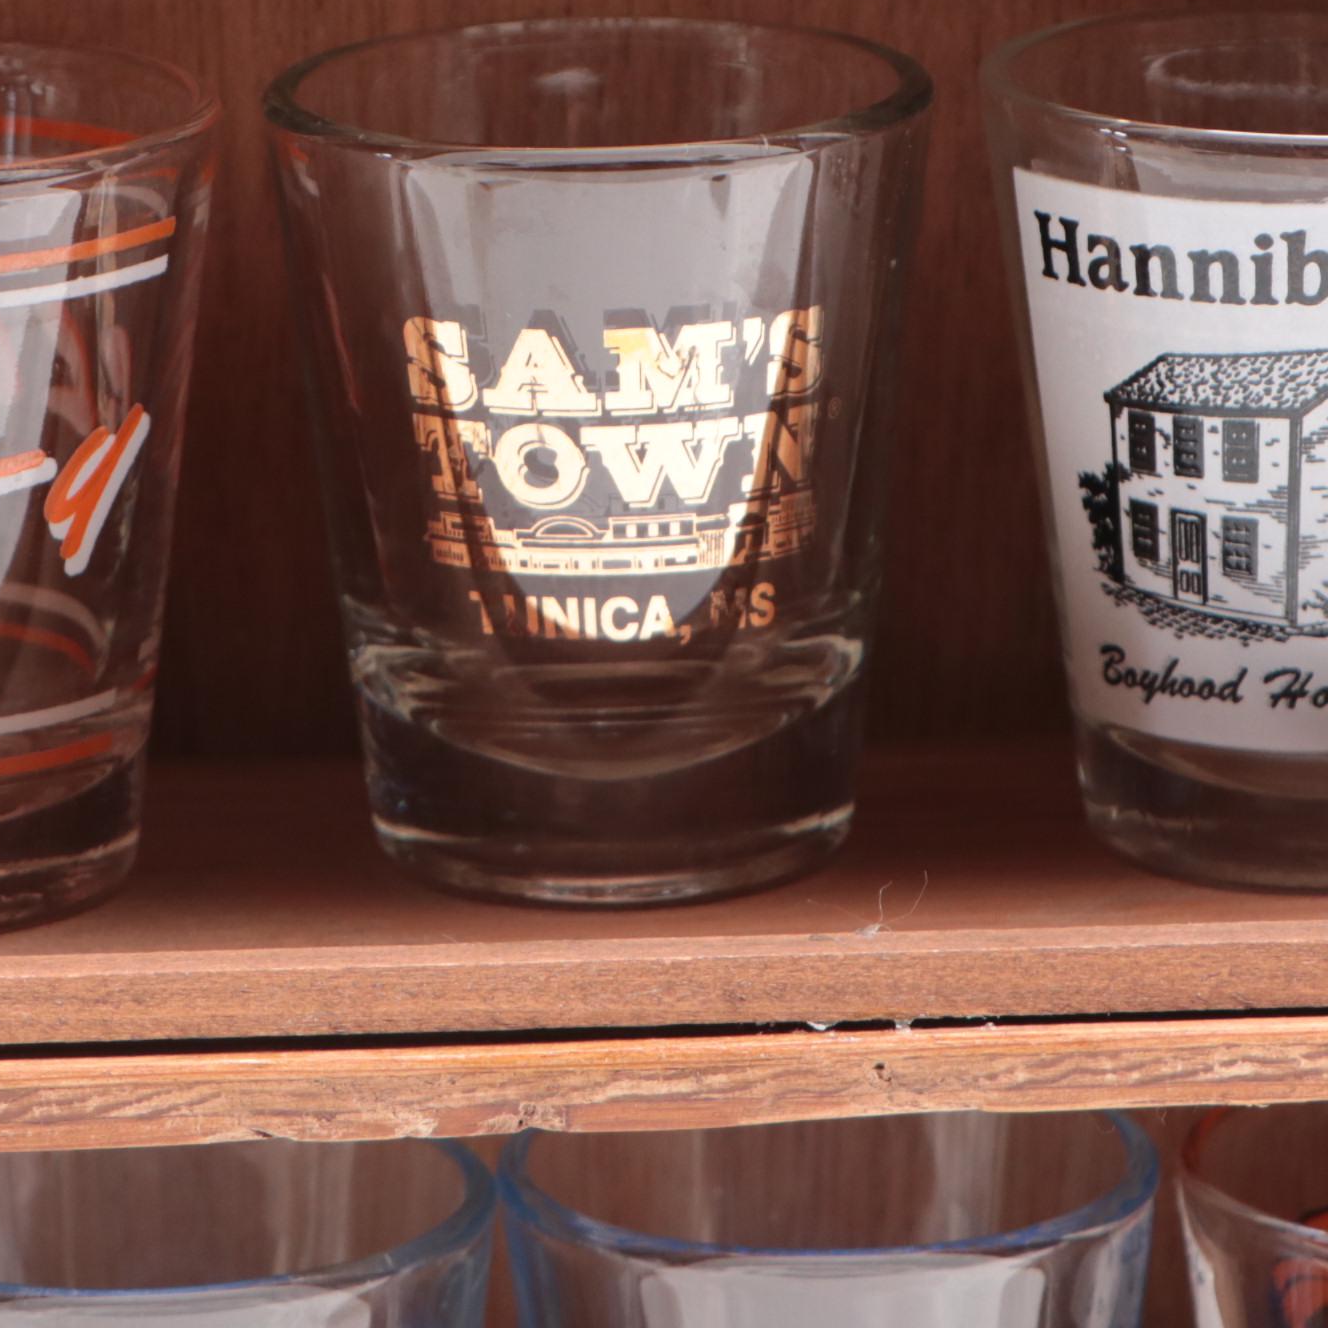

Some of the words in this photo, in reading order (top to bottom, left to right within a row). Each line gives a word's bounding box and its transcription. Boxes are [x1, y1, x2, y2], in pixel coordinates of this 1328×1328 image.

[403, 304, 825, 417] SAM'S
[412, 402, 819, 510] TOWN
[1099, 643, 1249, 706] Boyhood
